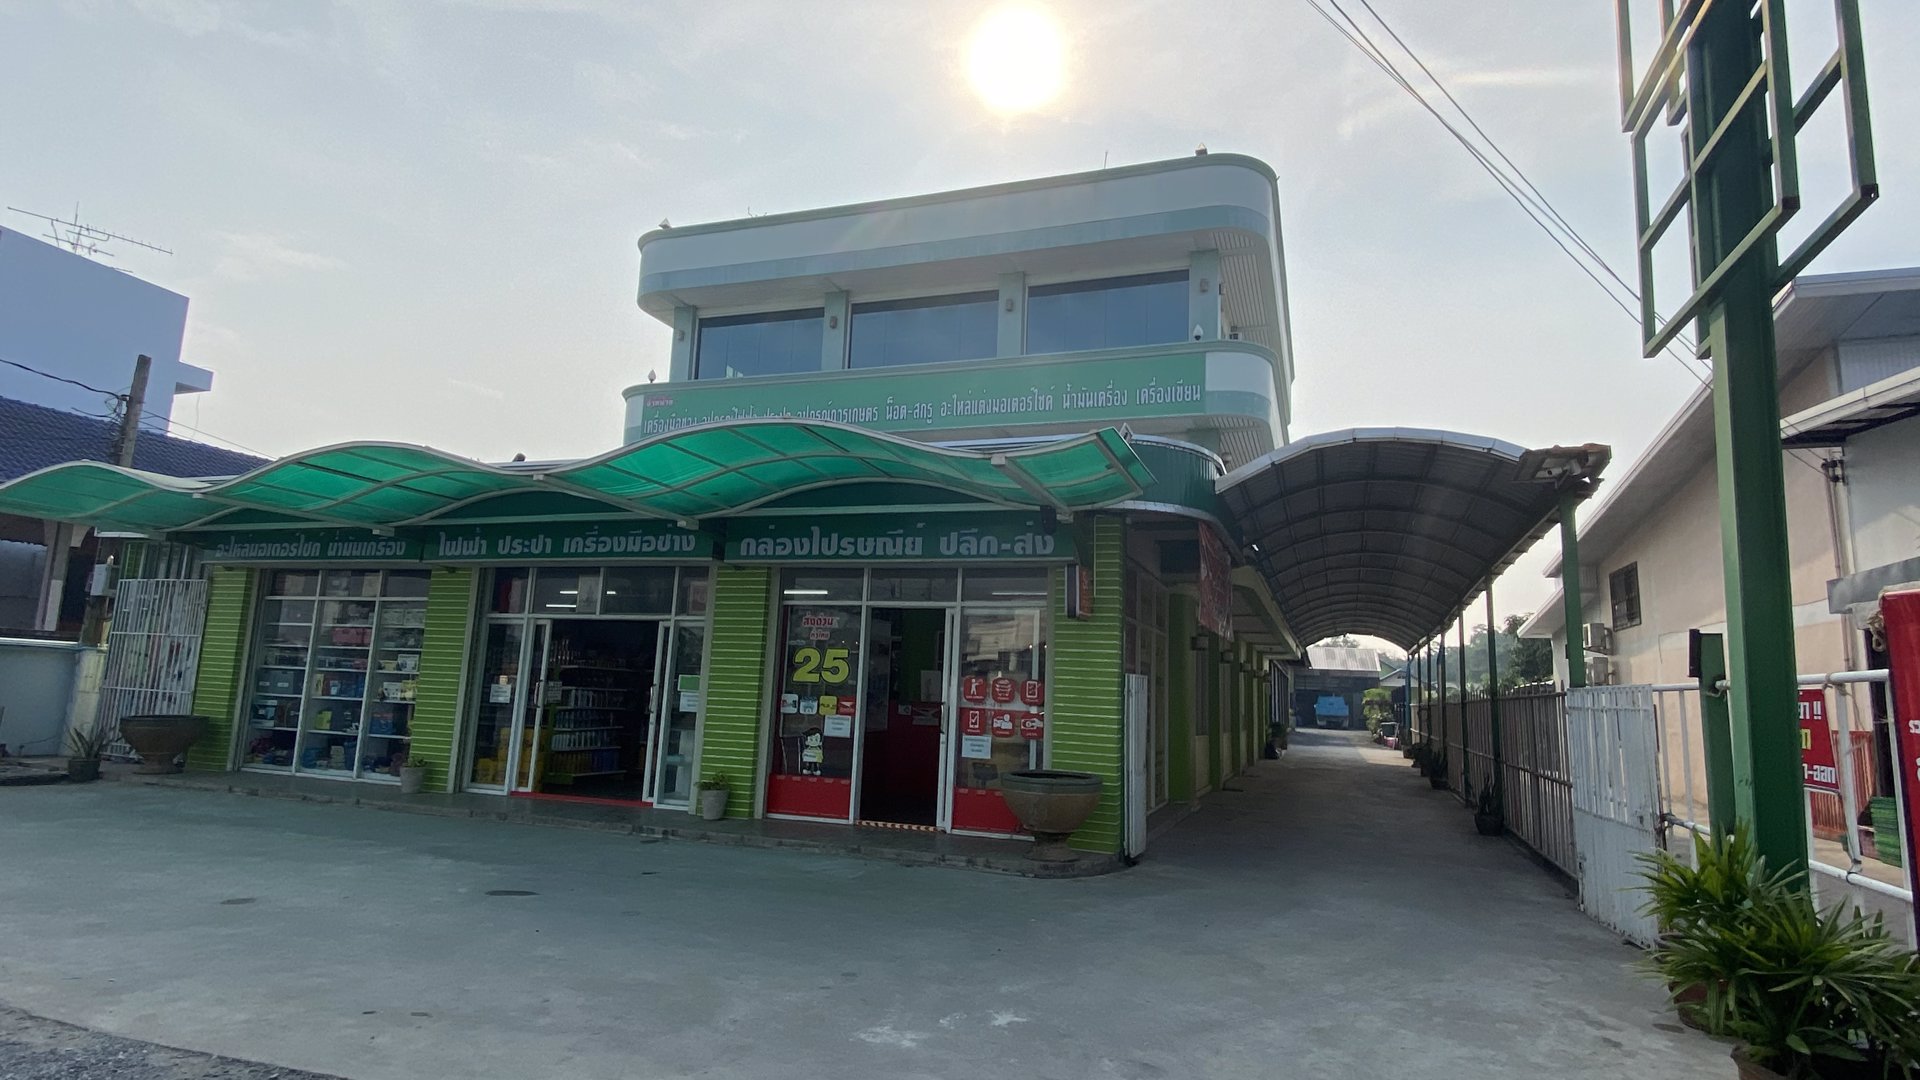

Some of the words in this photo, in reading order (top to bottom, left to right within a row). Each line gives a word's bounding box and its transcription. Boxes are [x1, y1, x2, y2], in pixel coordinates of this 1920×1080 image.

[1062, 379, 1128, 409] น้ำมันเครื่อง
[1136, 376, 1201, 404] เครื่องเขียน
[438, 526, 488, 556] ไฟฟ้า
[497, 534, 552, 555] ประปา
[562, 523, 697, 553] เครื่องมือช่าง
[739, 522, 926, 556] กล่องไปรษณีย์
[939, 520, 1056, 556] ปลีก-ส่ง
[793, 647, 851, 683] 25
